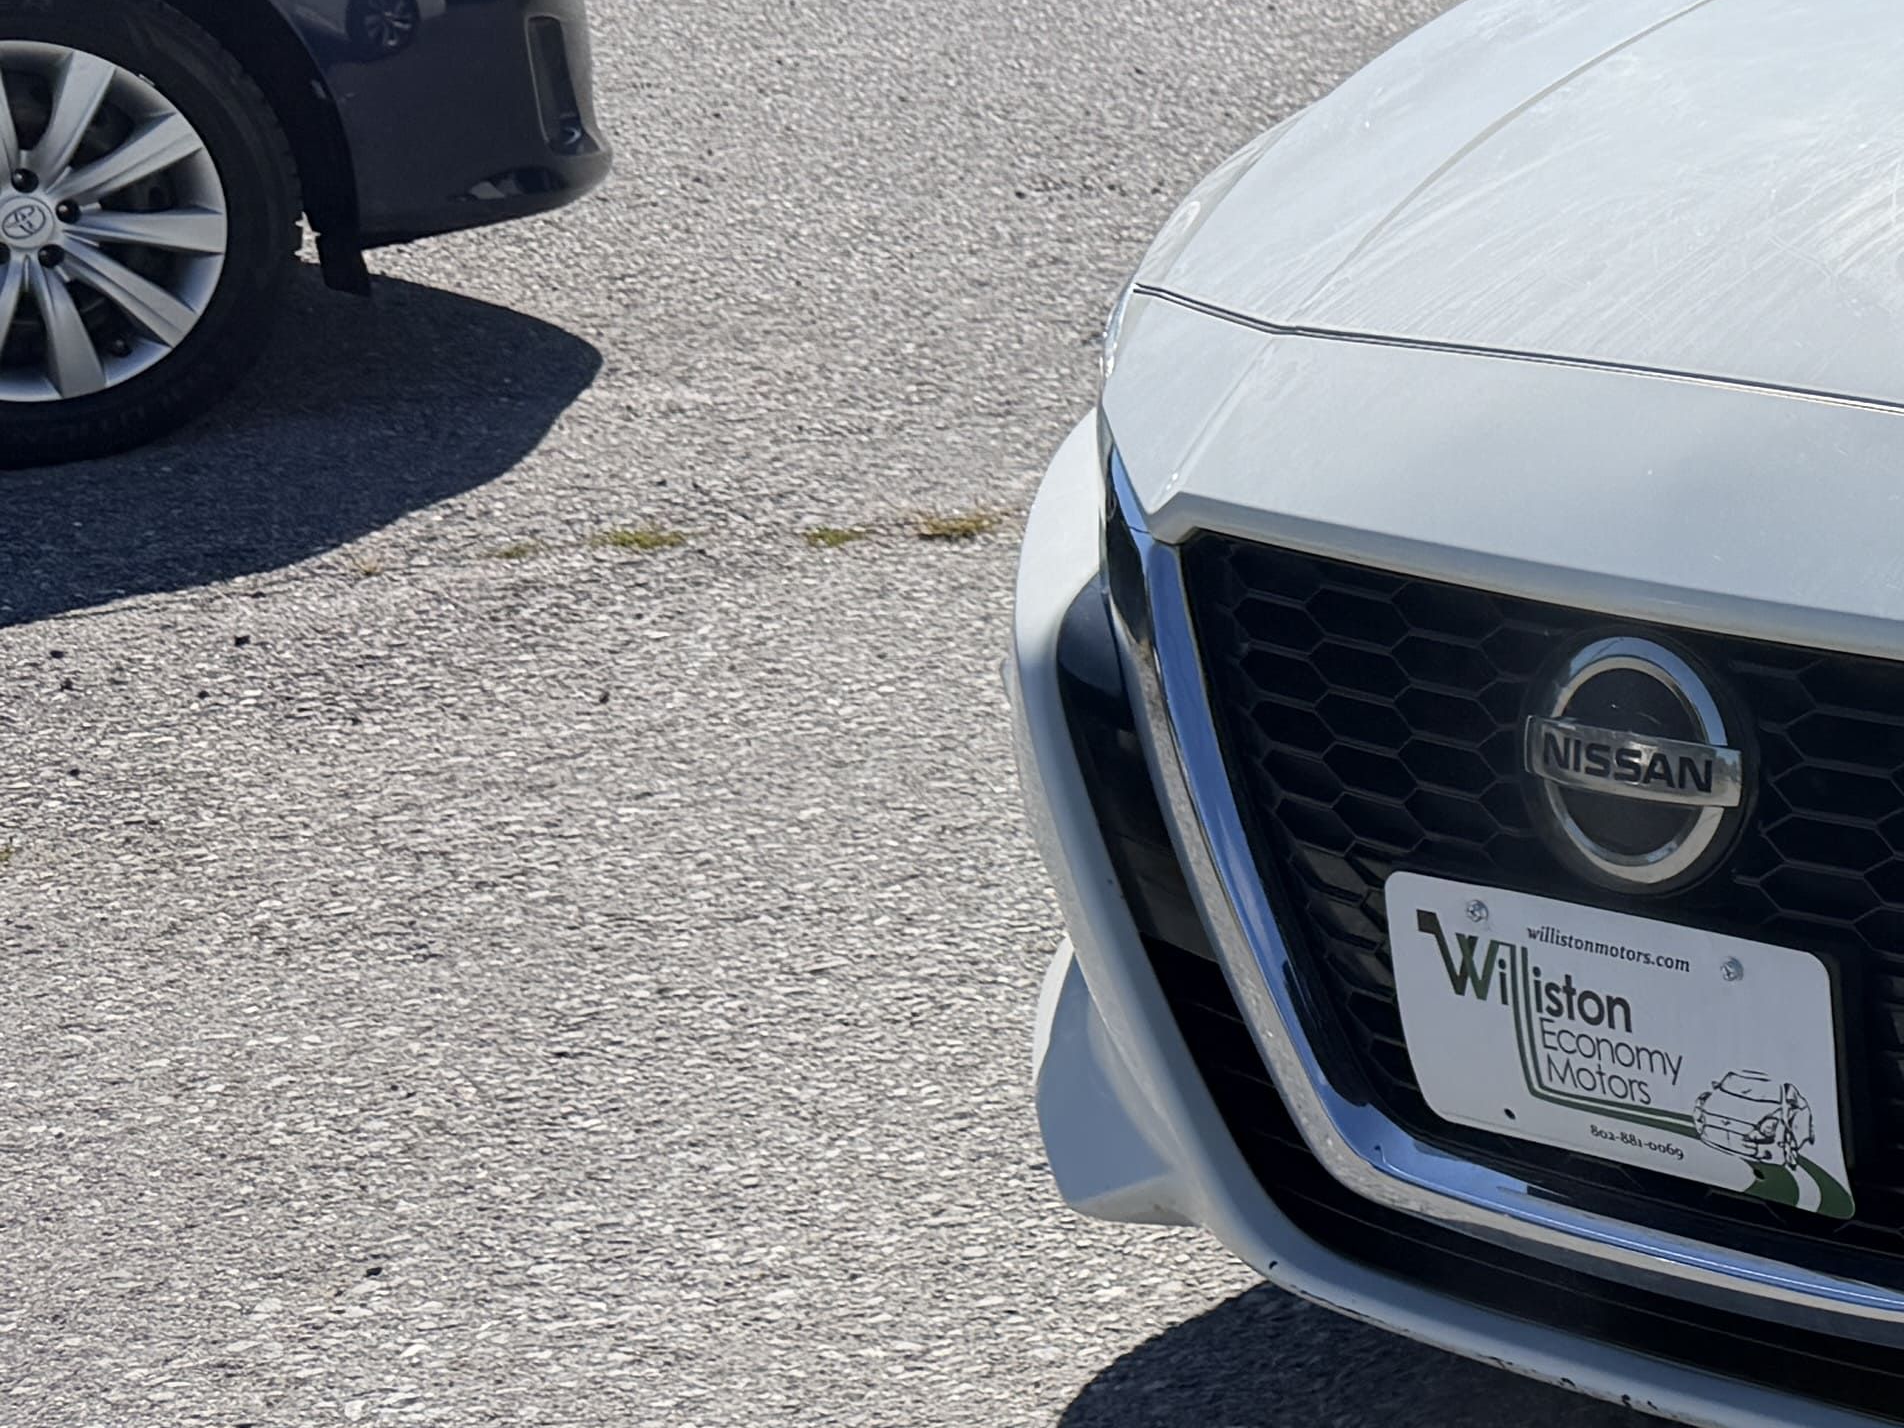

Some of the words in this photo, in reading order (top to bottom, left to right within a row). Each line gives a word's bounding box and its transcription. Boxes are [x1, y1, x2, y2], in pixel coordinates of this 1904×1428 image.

[1543, 732, 1713, 794] NISSAN
[1416, 909, 1633, 1033] Williston
[1526, 925, 1690, 973] willistonmotors.com
[1539, 1018, 1683, 1085] Economy
[1547, 1054, 1652, 1105] Motors
[1590, 1124, 1685, 1161] 802-881-0069
